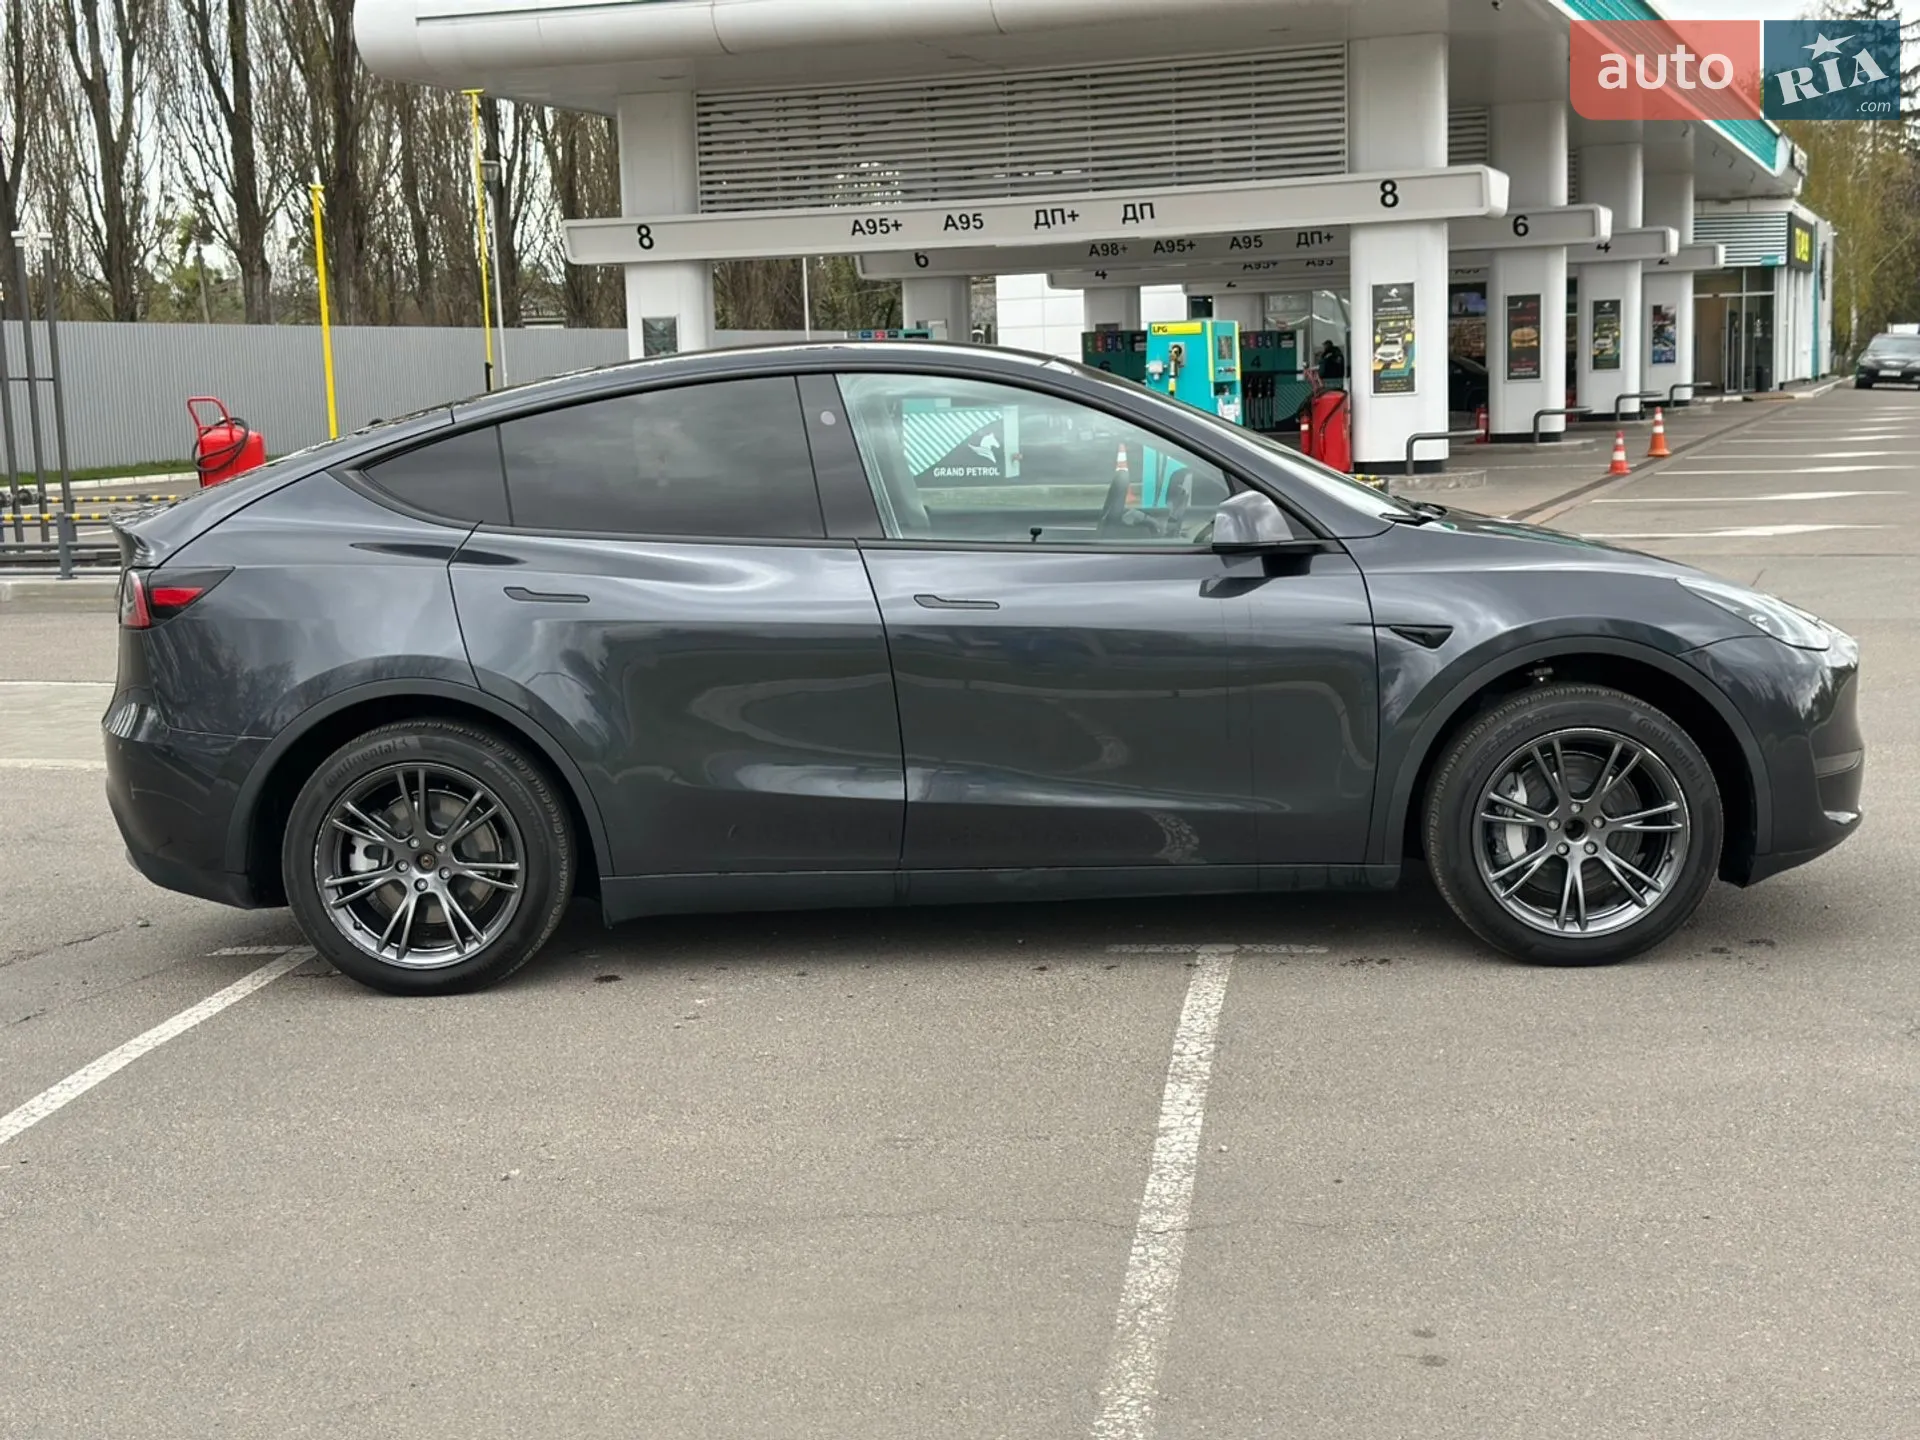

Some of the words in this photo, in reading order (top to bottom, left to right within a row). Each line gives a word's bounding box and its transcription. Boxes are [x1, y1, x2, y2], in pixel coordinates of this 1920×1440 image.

[637, 224, 655, 250] 8
[851, 217, 904, 236] А95+
[943, 213, 984, 231] А95
[1033, 208, 1080, 230] ДП+
[1121, 202, 1155, 225] ДП
[1379, 179, 1399, 208] 8
[1512, 214, 1530, 237] 6
[1296, 230, 1335, 249] ДП+
[933, 467, 965, 477] GRAND
[966, 466, 1000, 477] PETROL
